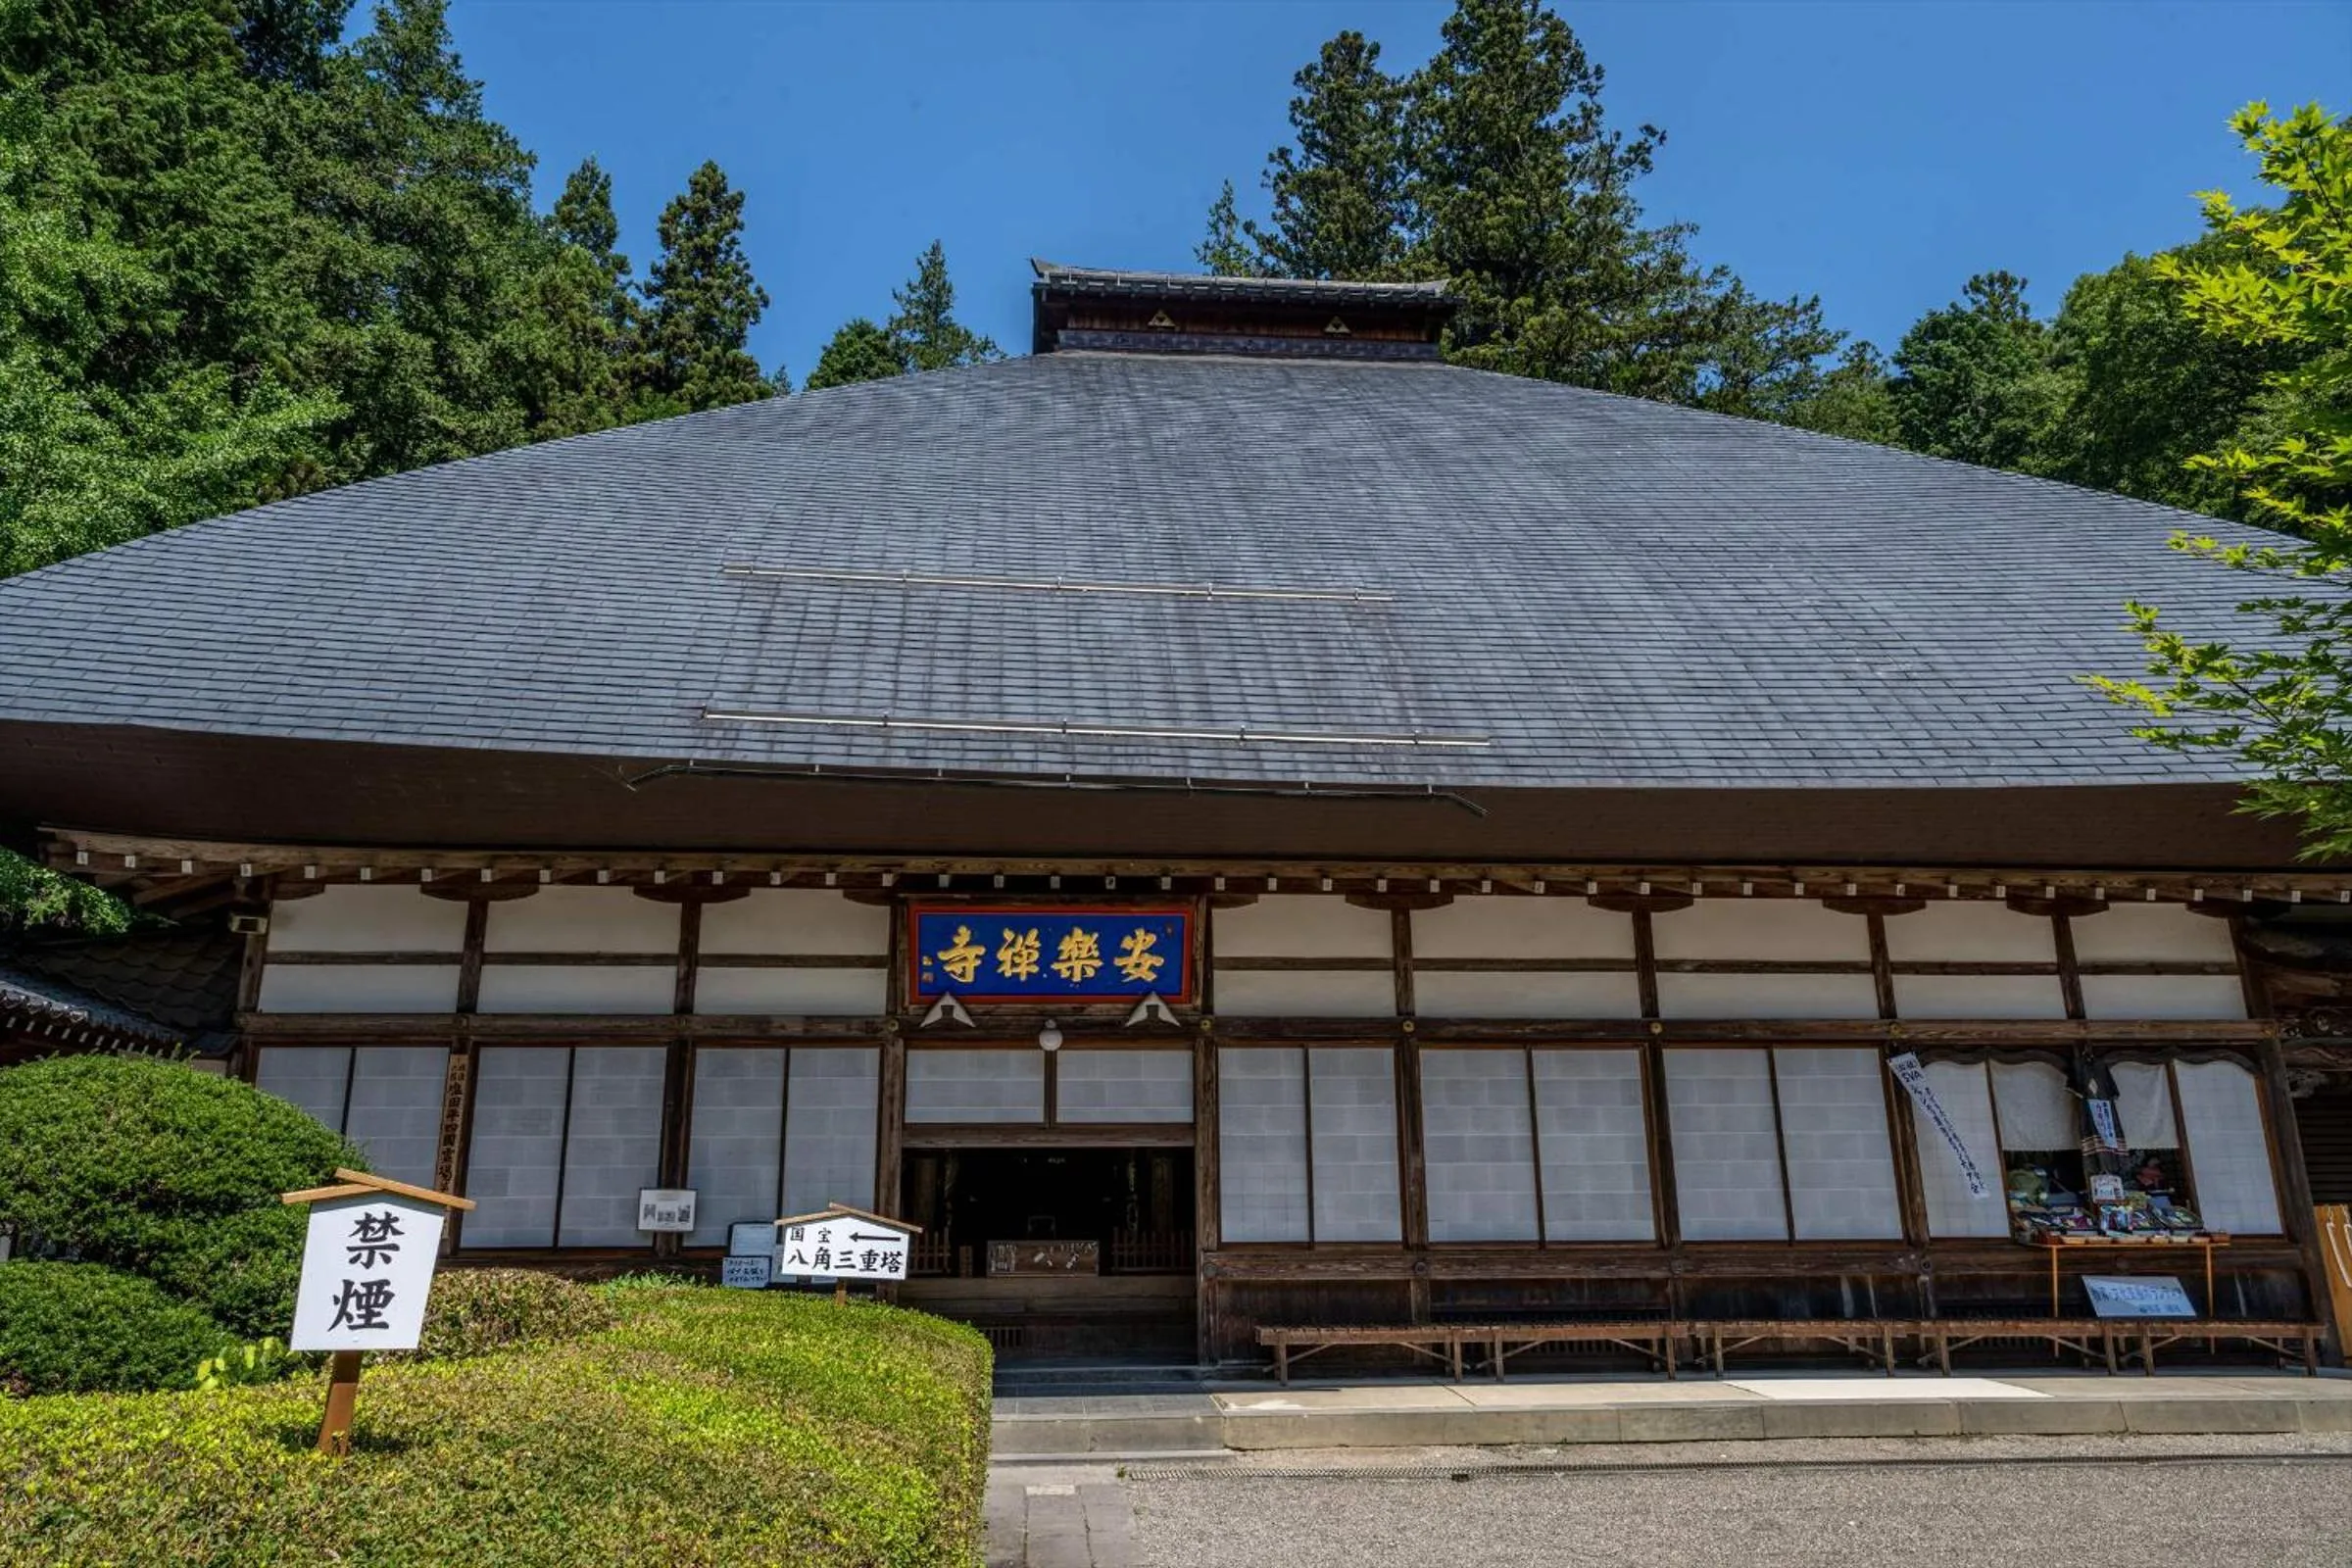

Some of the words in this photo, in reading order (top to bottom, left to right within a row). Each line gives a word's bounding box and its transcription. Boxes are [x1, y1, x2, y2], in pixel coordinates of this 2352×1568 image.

[790, 1226, 832, 1243] 国宝
[327, 1211, 406, 1333] 禁煙
[788, 1247, 905, 1274] 八角三重塔
